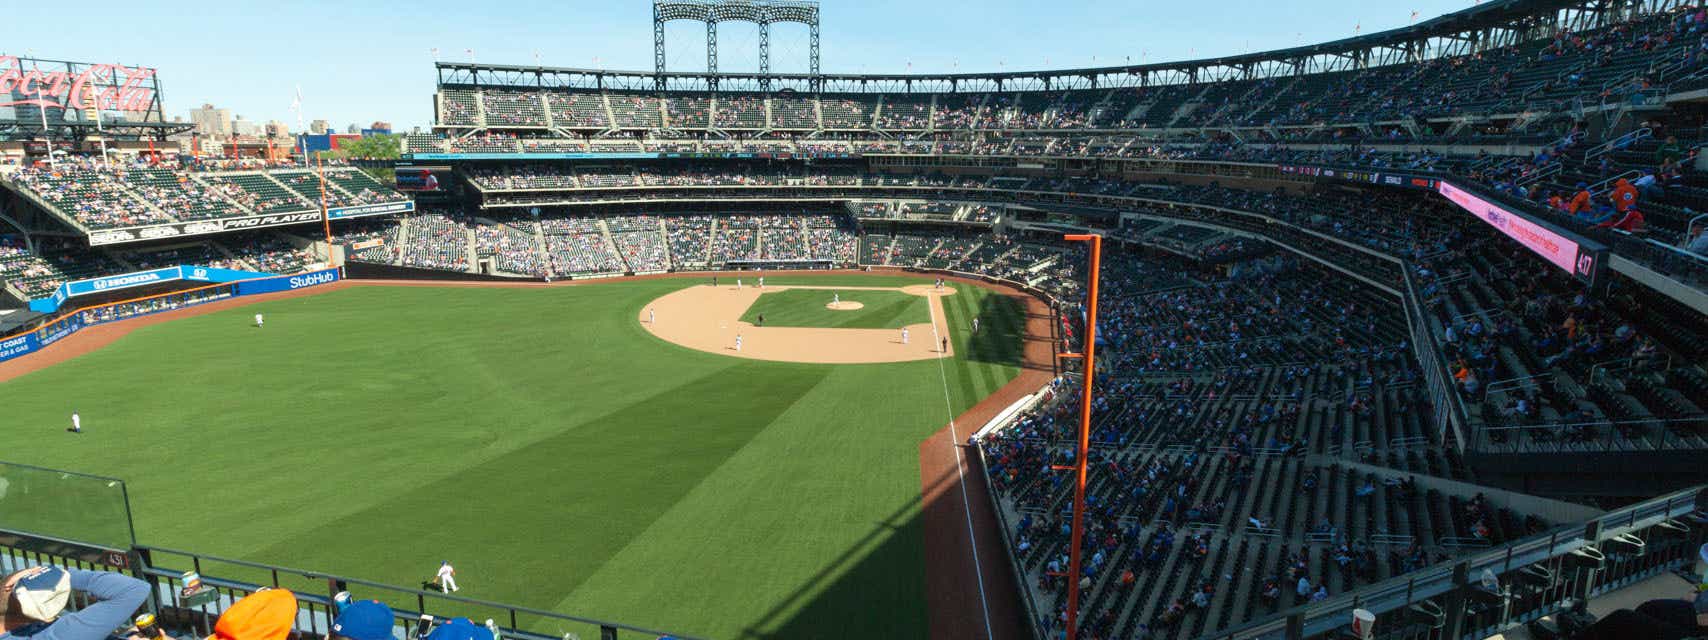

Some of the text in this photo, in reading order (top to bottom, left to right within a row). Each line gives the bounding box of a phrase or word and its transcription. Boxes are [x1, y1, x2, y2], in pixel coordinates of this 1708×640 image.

[223, 218, 260, 229] PRO
[259, 212, 320, 225] PLAYER
[107, 273, 161, 287] HONDA
[289, 271, 334, 289] StubHub
[3, 336, 27, 348] COAST
